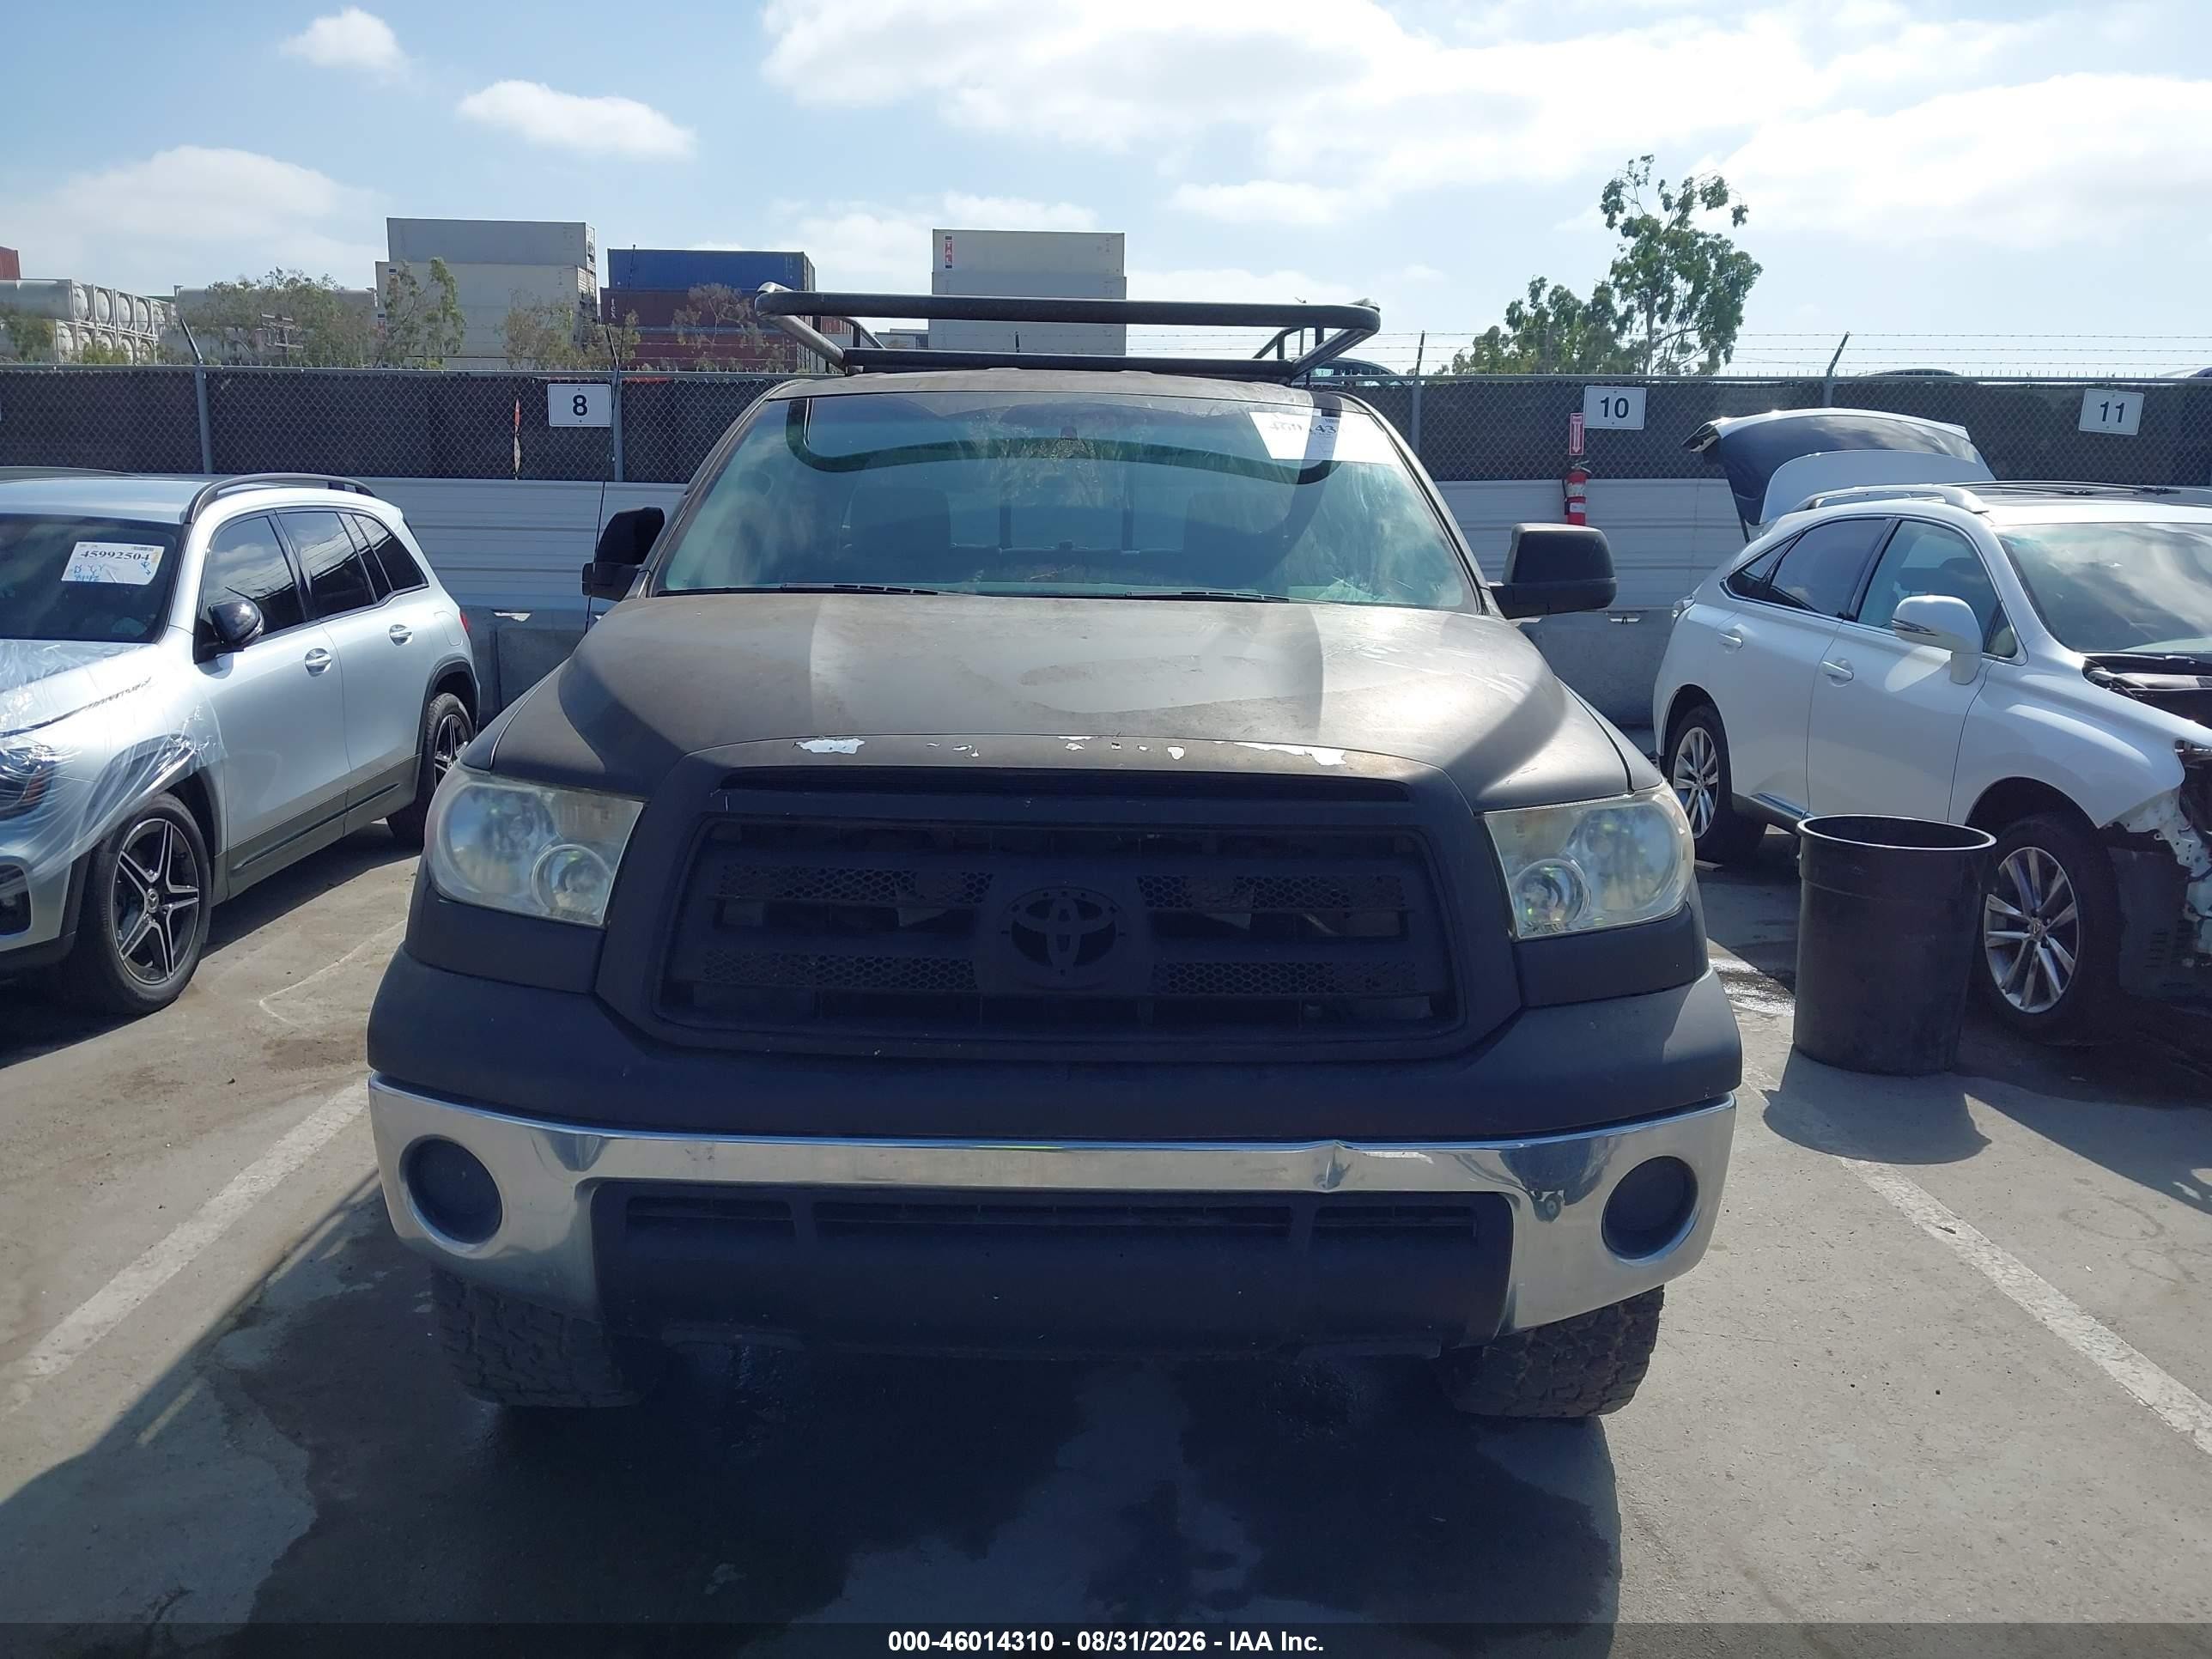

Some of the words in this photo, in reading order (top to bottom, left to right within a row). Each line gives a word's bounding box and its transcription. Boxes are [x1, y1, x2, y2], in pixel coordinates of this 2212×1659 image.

[573, 395, 588, 416] 8
[1600, 397, 1629, 419] 10
[2100, 401, 2125, 423] 11
[80, 550, 150, 562] 45992504
